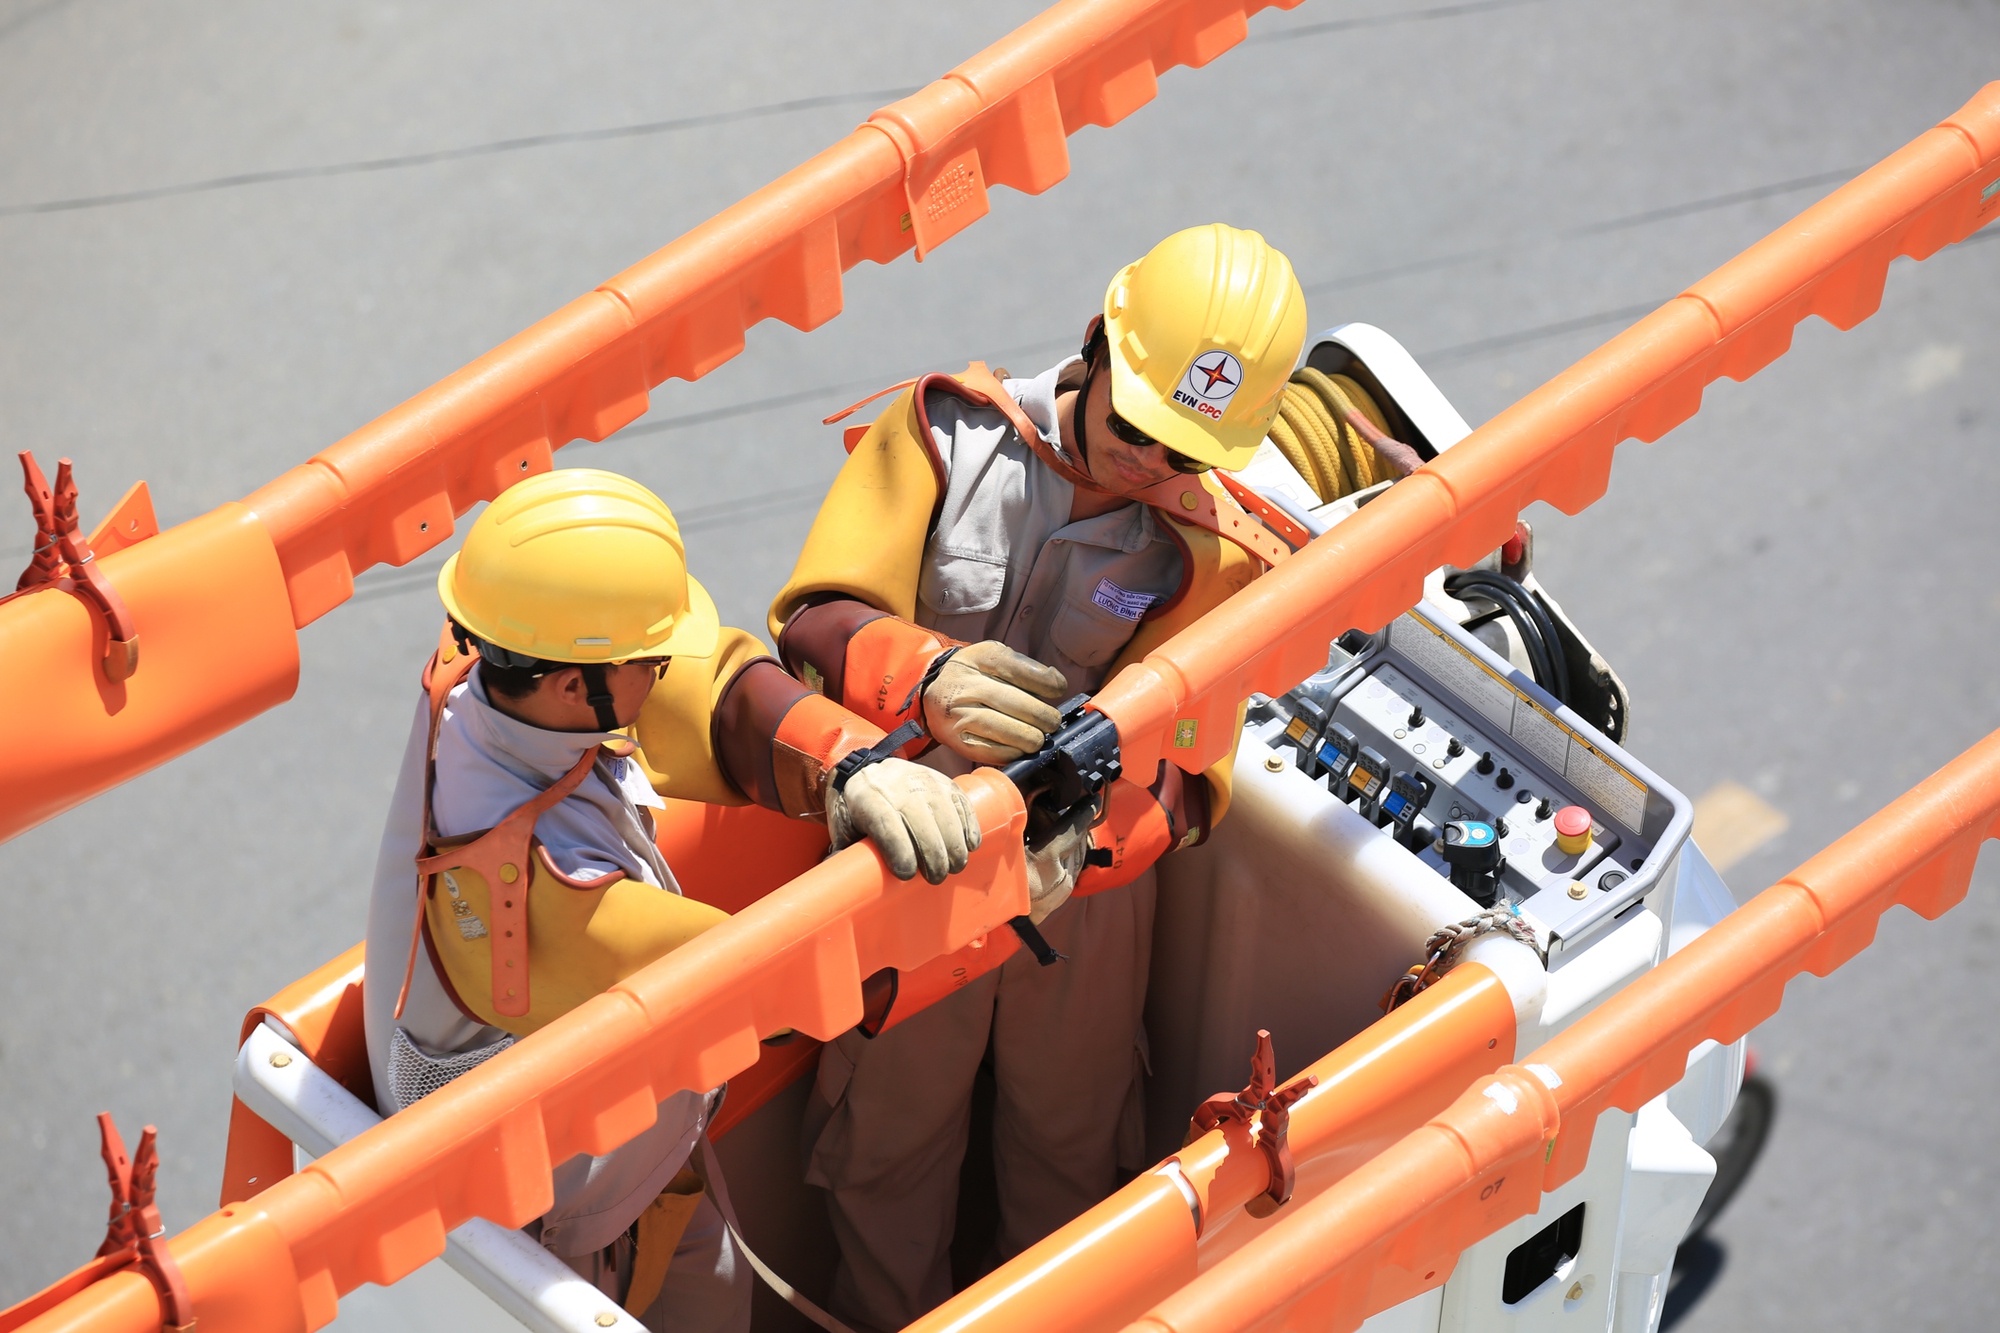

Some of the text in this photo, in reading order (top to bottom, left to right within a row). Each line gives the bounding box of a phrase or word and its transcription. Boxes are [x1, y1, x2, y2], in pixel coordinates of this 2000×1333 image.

[930, 164, 965, 195] CHANCE
[1173, 390, 1222, 419] EVN CPC
[1120, 607, 1137, 618] ĐÌNH
[1446, 638, 1471, 660] CAUTION
[1533, 704, 1560, 726] CAUTION
[1595, 750, 1621, 772] CAUTION
